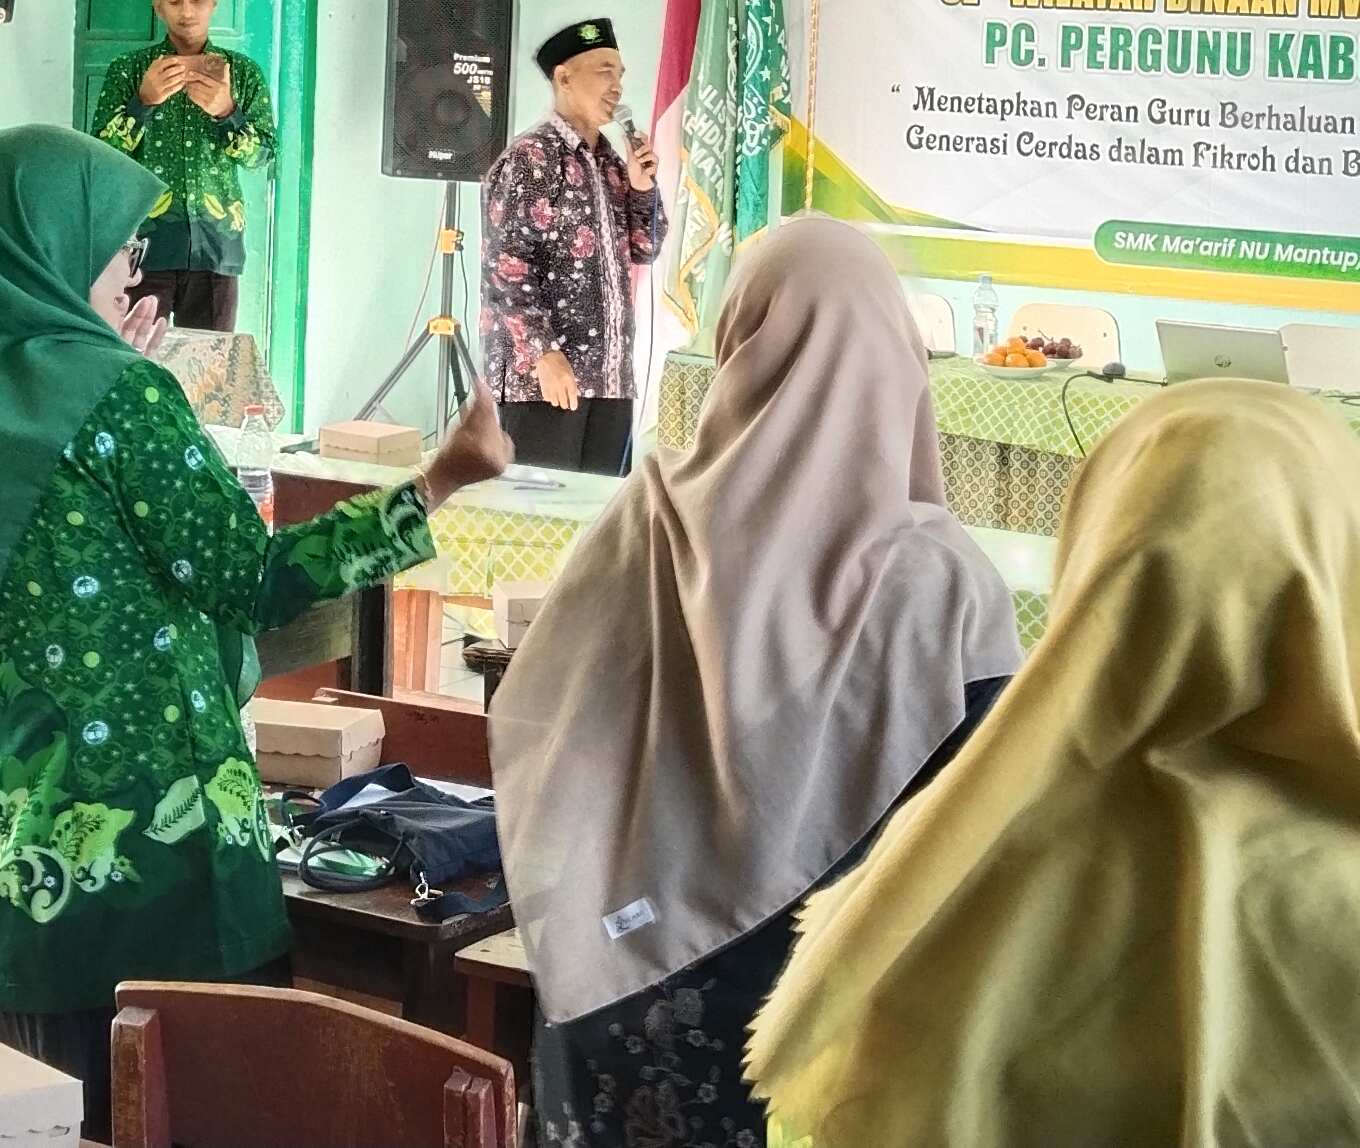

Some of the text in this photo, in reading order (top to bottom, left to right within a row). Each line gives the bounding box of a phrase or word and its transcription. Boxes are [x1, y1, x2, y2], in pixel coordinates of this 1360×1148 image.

[453, 62, 478, 75] 500
[983, 20, 1047, 67] PC.
[1059, 24, 1254, 77] PERGUNU
[911, 85, 1059, 121] Menetapkan
[1065, 95, 1140, 124] Peran
[1146, 98, 1211, 128] Guru
[1218, 101, 1357, 136] Berhaluan
[905, 123, 1010, 157] Generasi
[1015, 130, 1102, 162] Cerdas
[1107, 136, 1185, 168] dalam
[1191, 139, 1278, 174] Fikroh
[1283, 142, 1334, 176] dan
[1113, 229, 1157, 252] SMK
[1161, 233, 1236, 260] Ma’arif
[1240, 238, 1271, 262] NU
